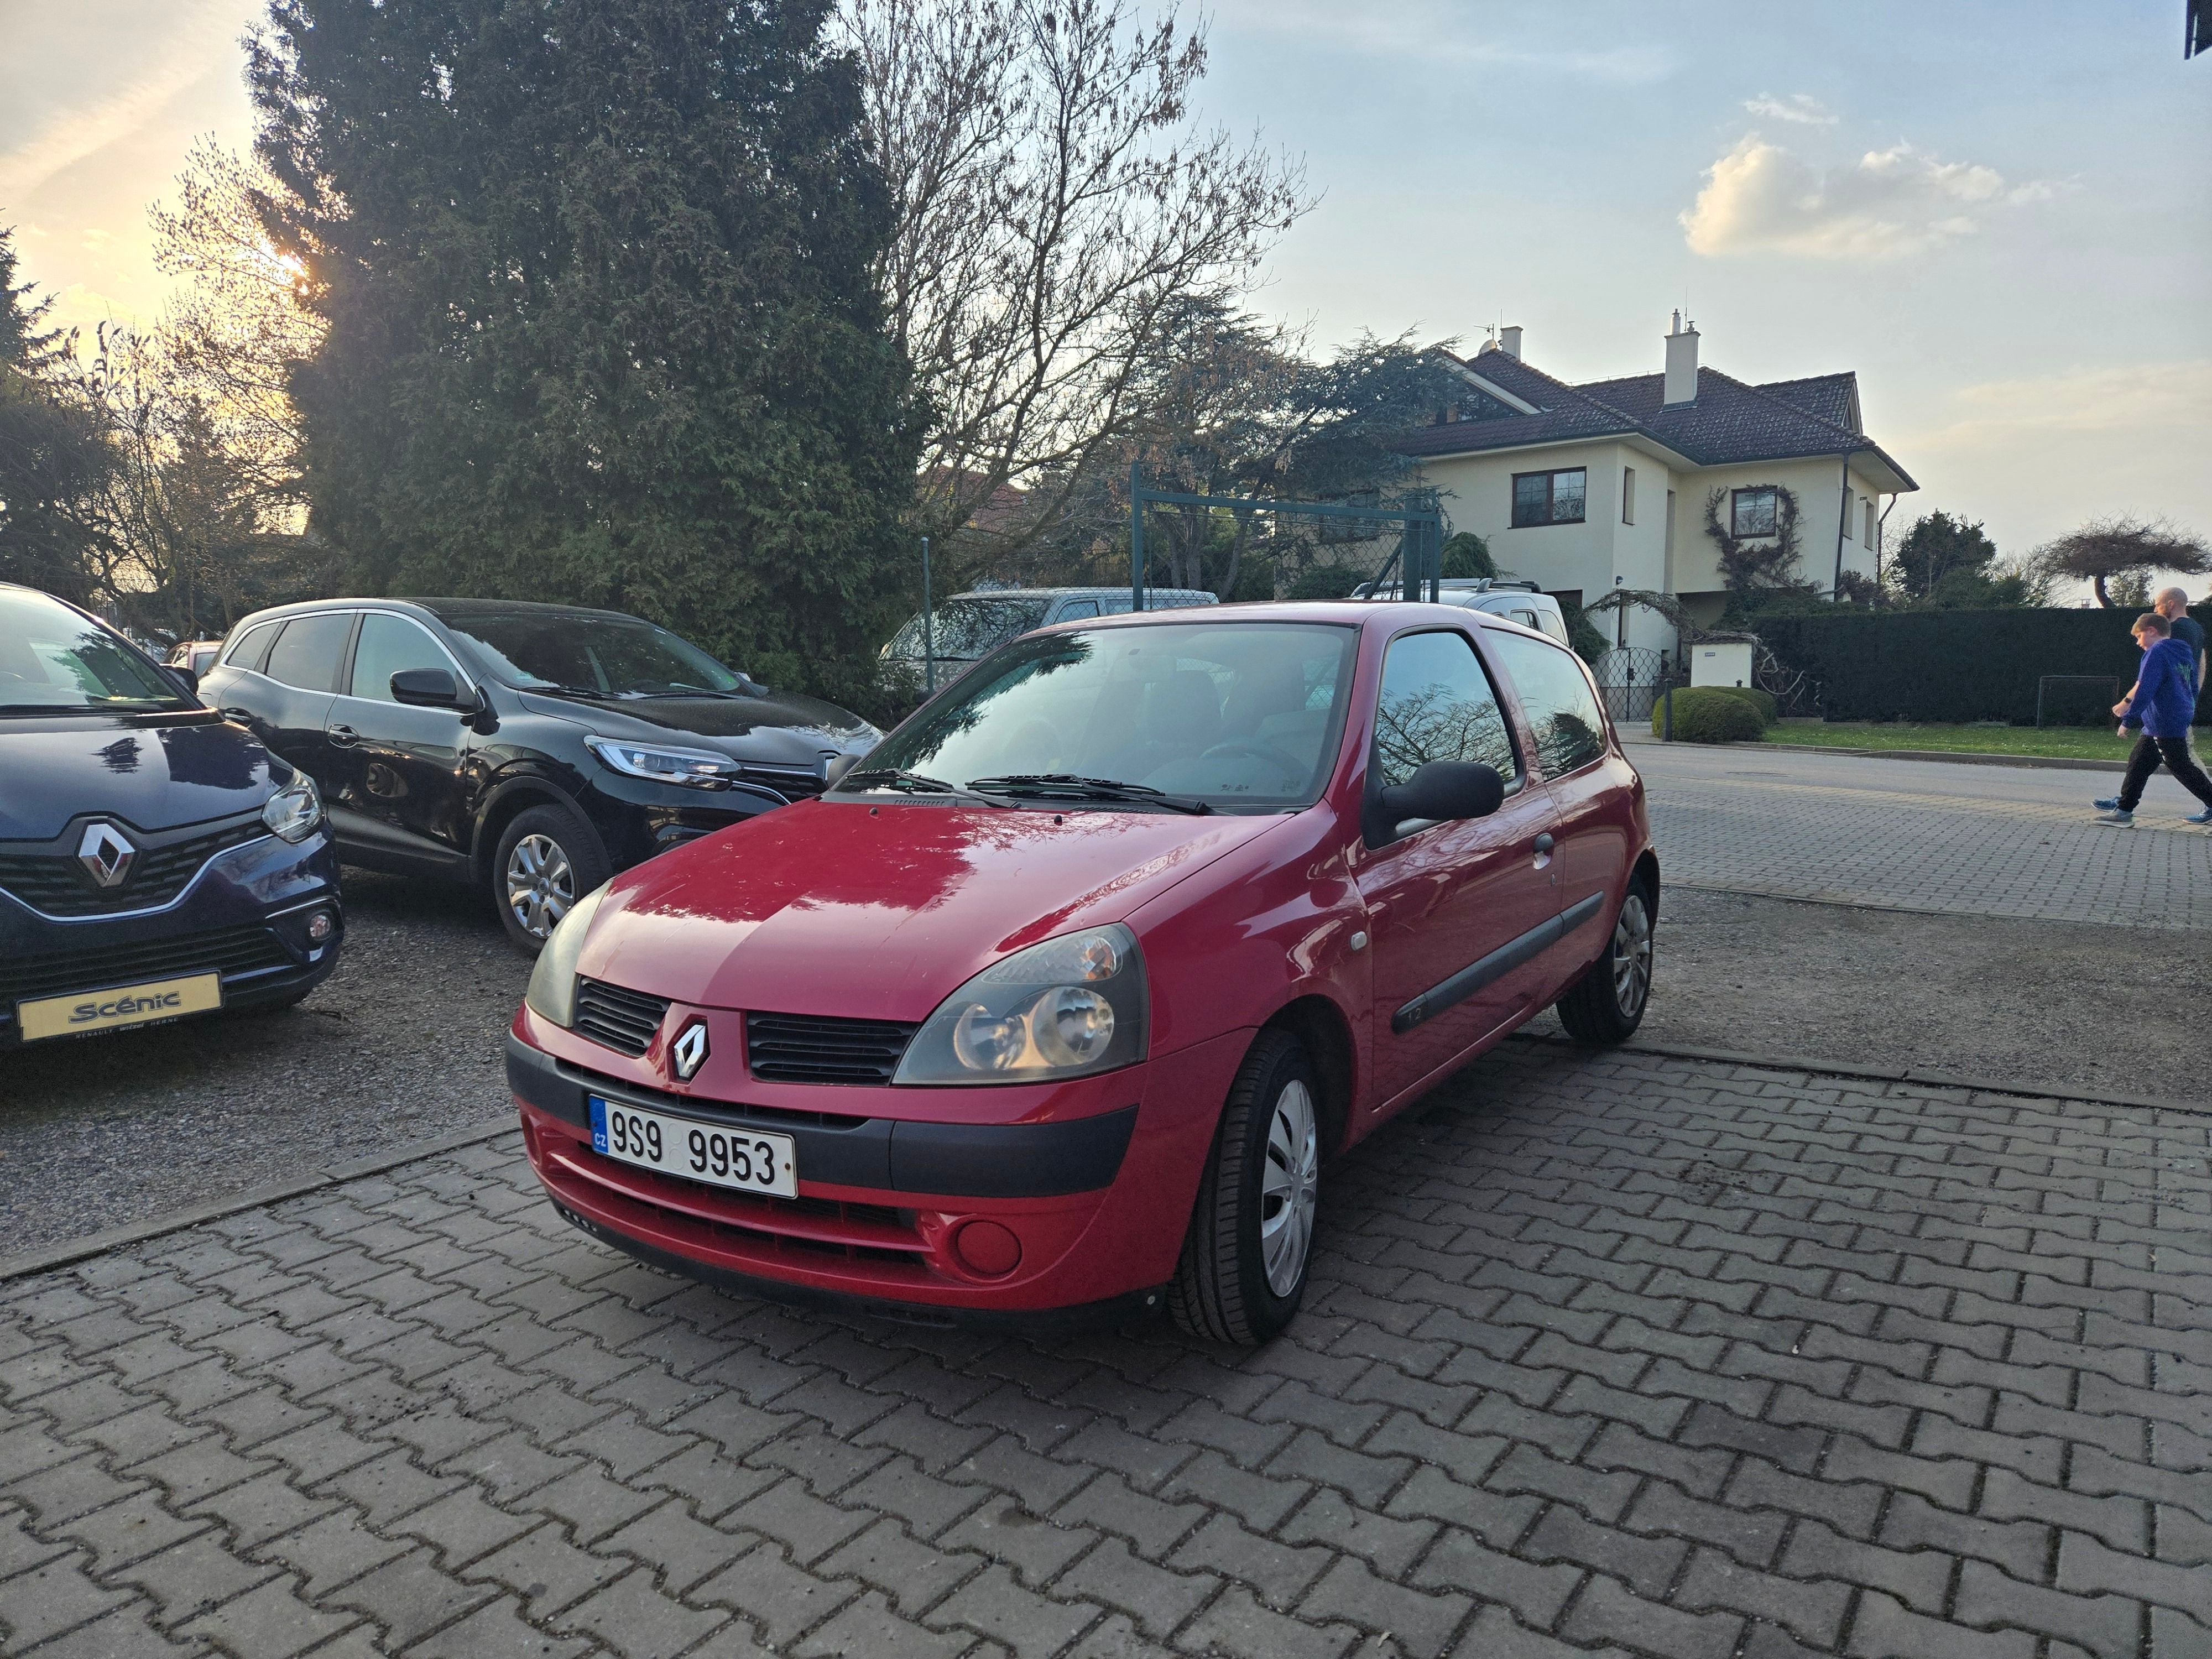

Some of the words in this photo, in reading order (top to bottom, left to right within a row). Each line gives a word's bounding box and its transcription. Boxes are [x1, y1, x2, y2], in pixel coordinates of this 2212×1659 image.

[68, 991, 181, 1023] Scénic
[75, 1029, 113, 1039] RENAULT
[150, 1017, 178, 1026] HERNE
[594, 1132, 607, 1147] CZ
[612, 1111, 662, 1162] 9S9
[688, 1129, 775, 1185] 9953
